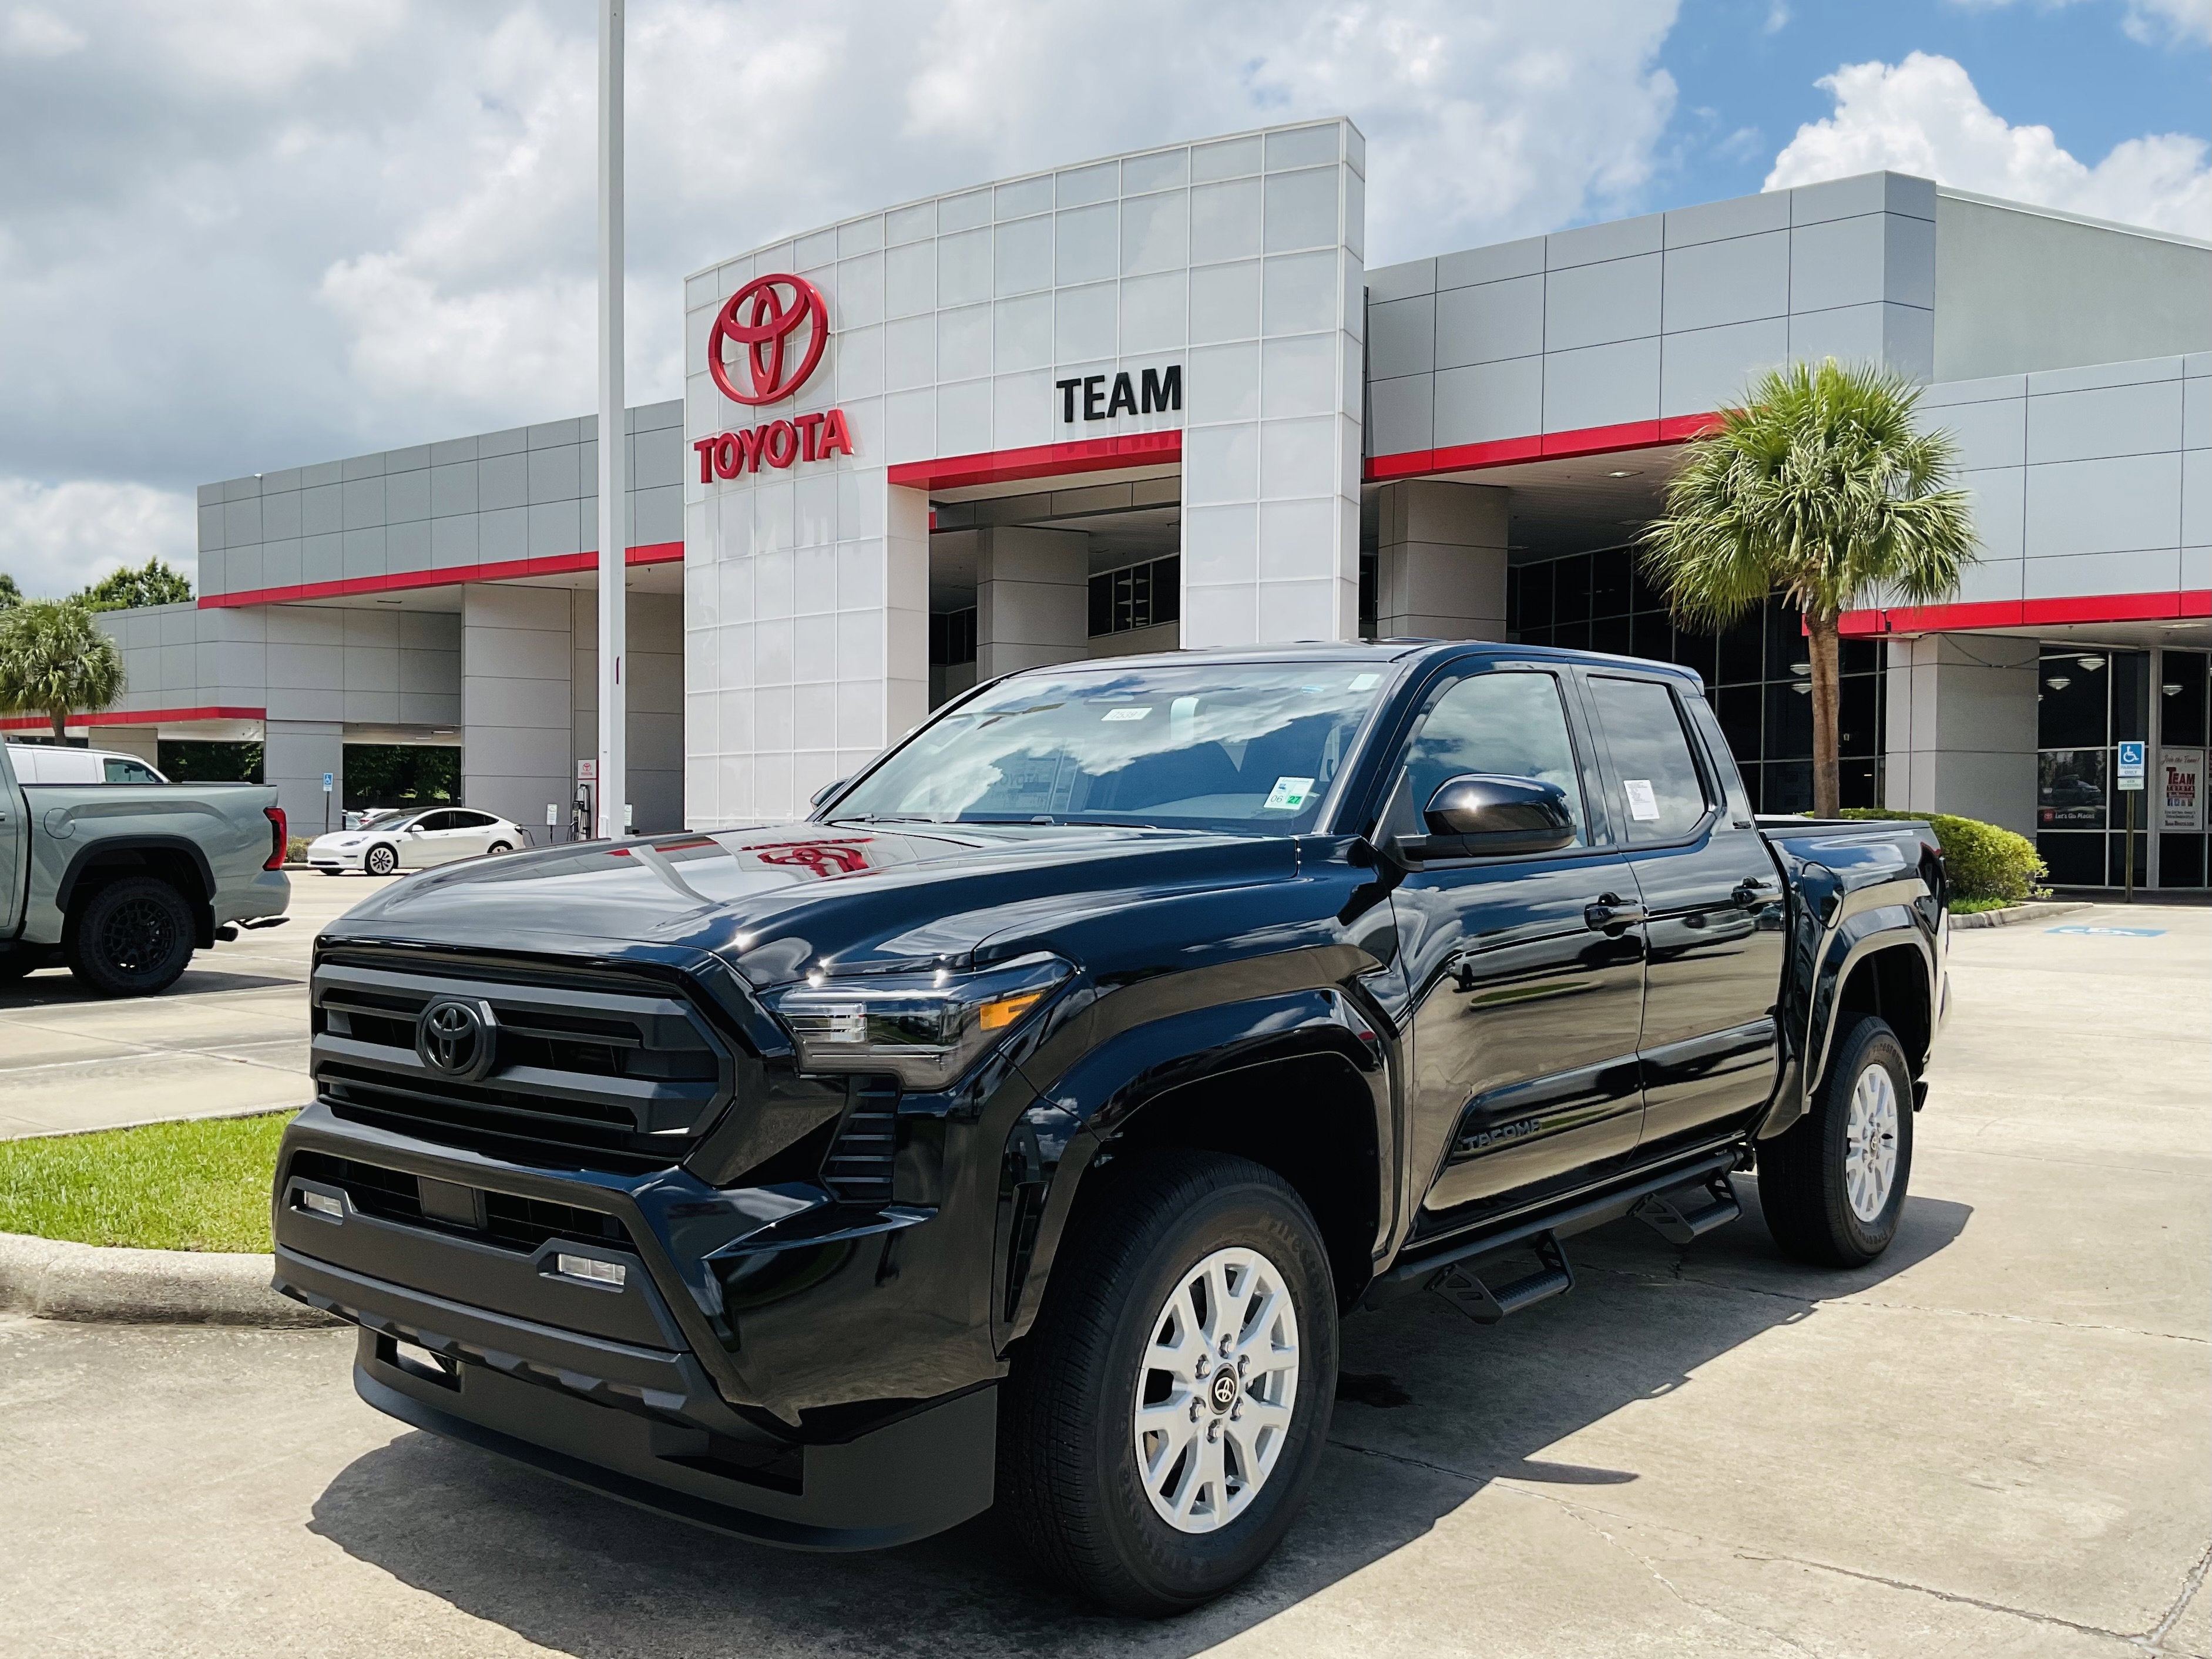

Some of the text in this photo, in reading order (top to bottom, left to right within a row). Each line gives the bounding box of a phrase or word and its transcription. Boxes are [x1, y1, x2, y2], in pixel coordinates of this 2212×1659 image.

[1056, 365, 1181, 423] TEAM
[694, 408, 853, 483] TOYOTA
[2166, 767, 2195, 785] TEAM
[1288, 795, 1301, 804] 27
[1462, 1119, 1542, 1150] TACOMA
